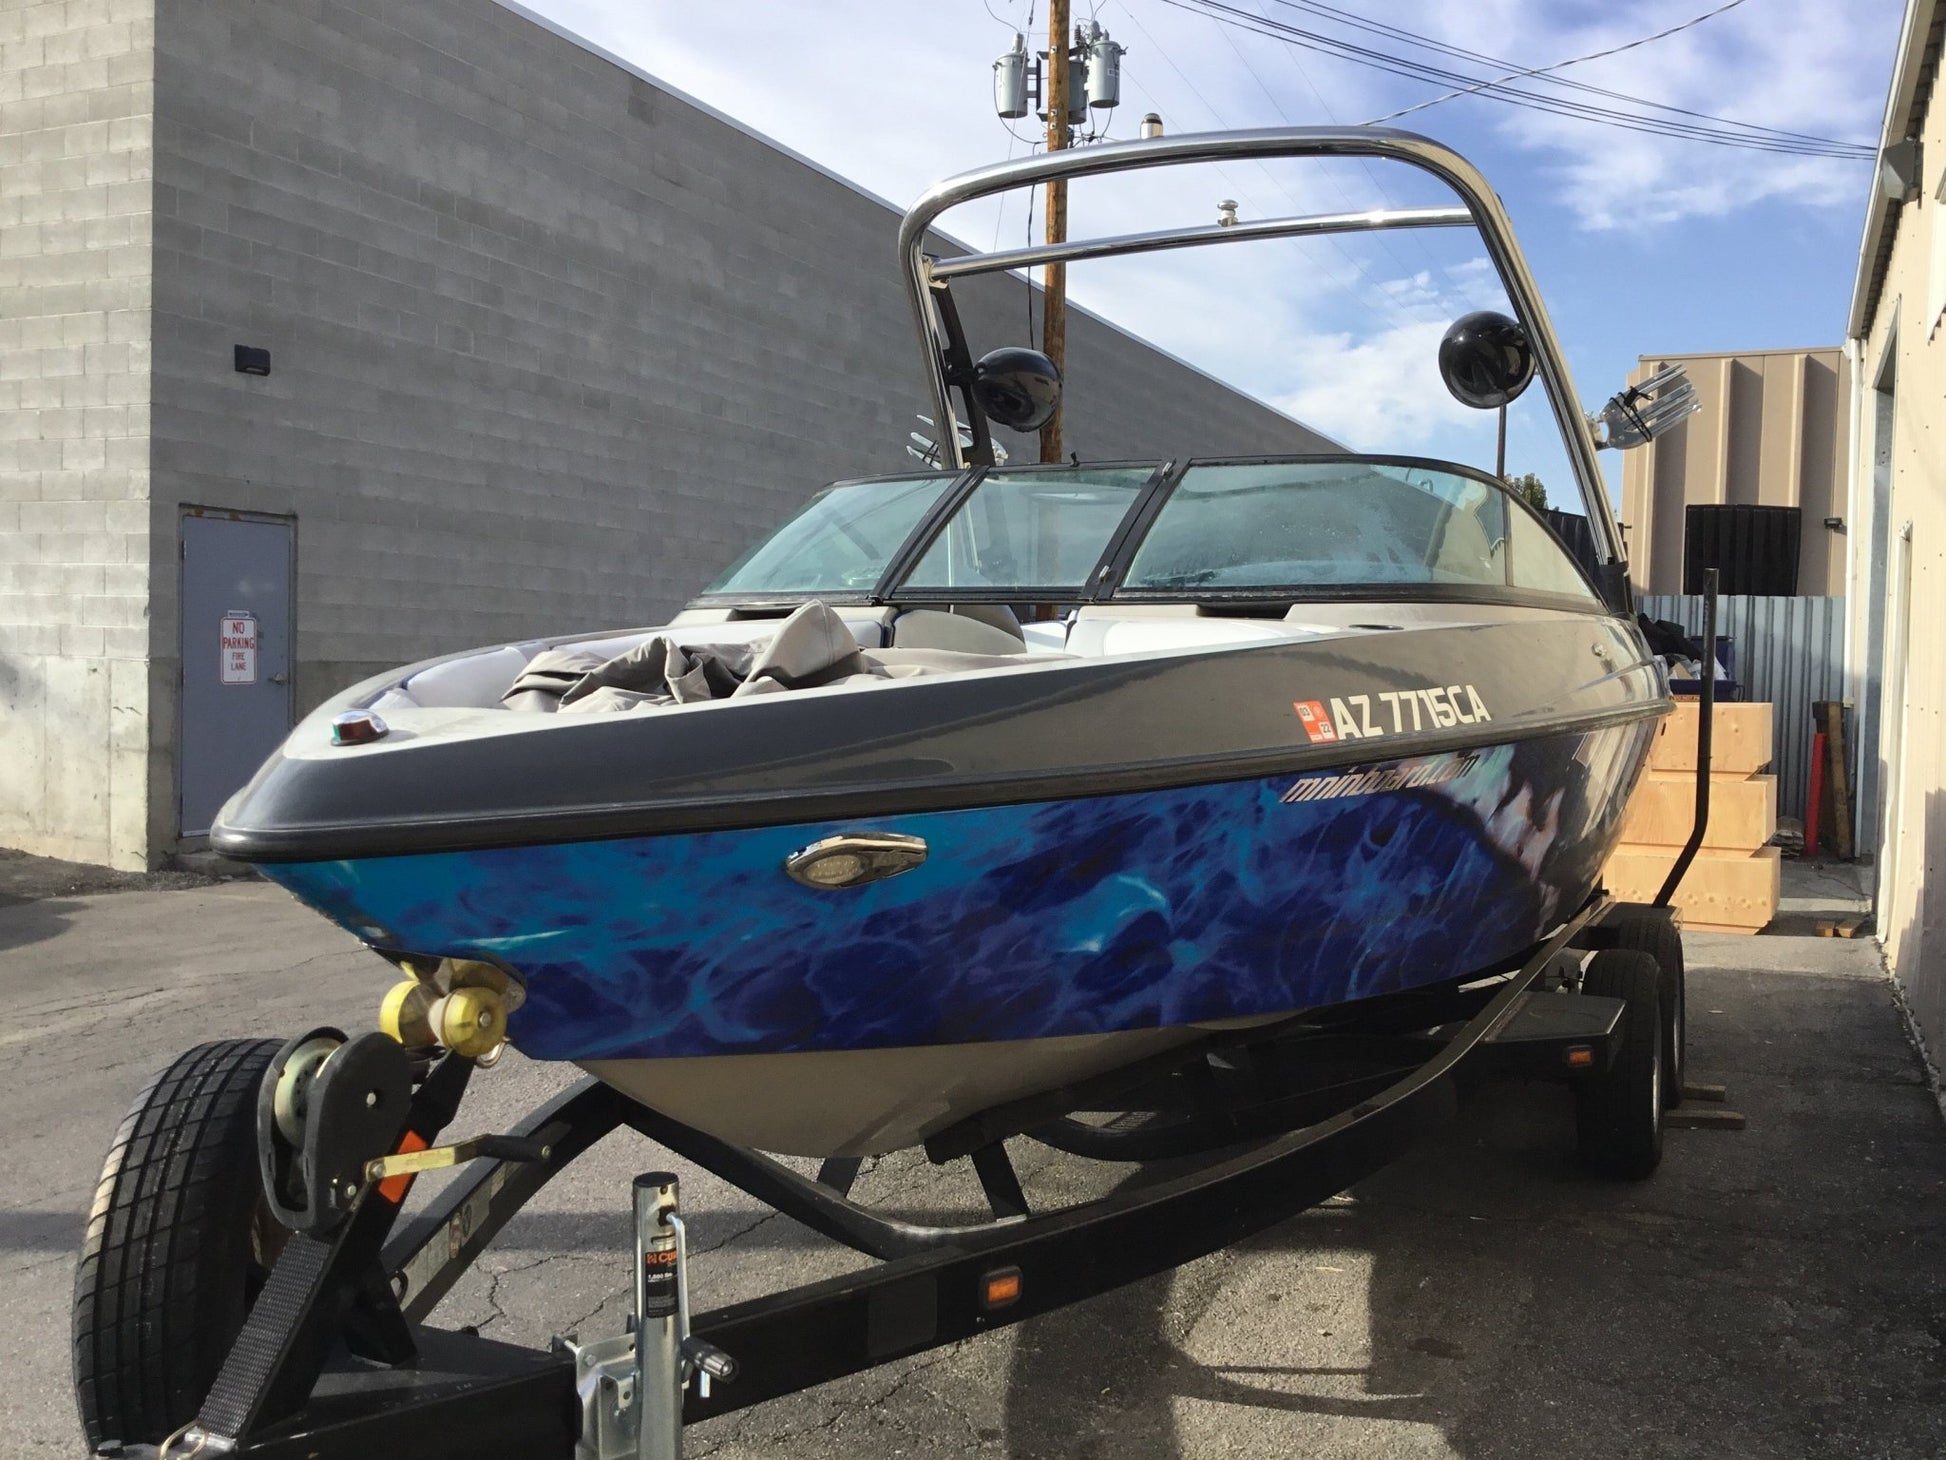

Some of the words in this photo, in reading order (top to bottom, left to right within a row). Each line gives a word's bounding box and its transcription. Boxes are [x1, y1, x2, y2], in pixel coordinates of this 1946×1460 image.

[232, 621, 245, 634] NO
[222, 637, 255, 649] PARKING
[232, 652, 245, 661] FIRE
[231, 662, 246, 671] LANE
[1329, 694, 1384, 740] AZ
[1378, 685, 1491, 733] 7715CA
